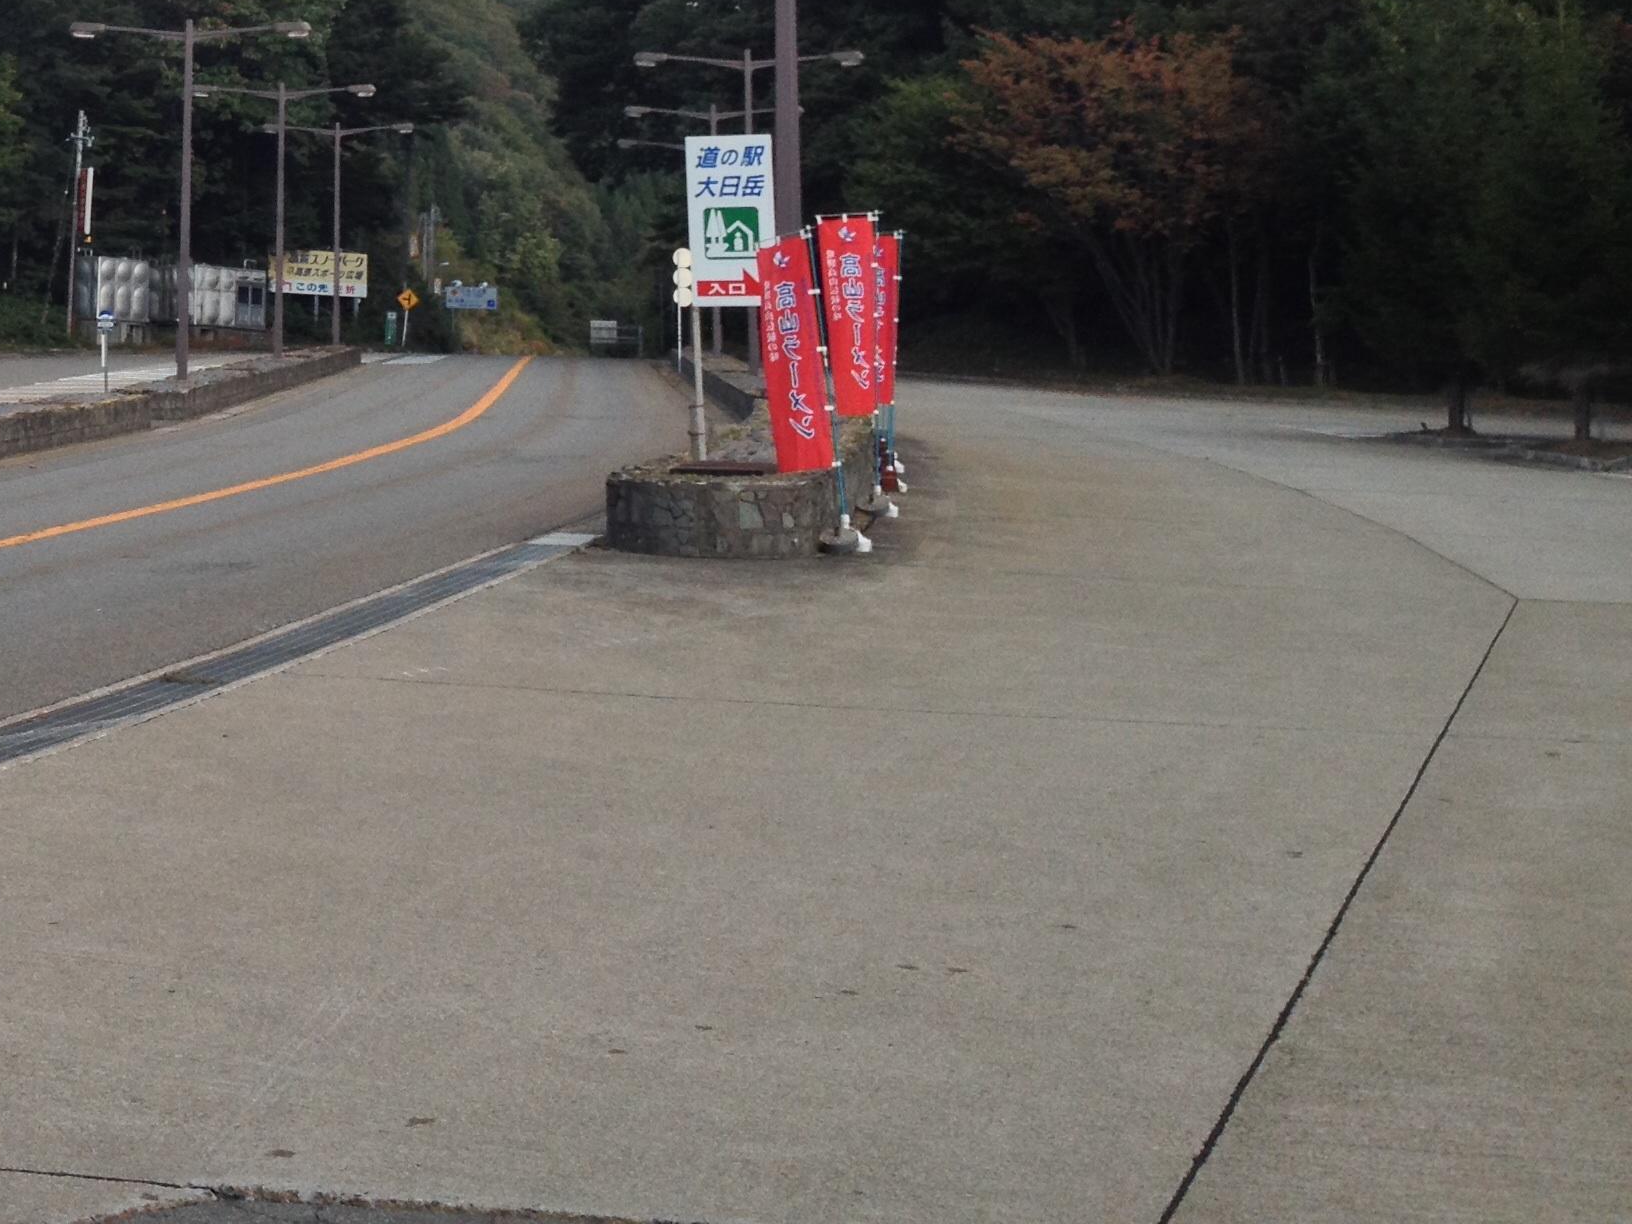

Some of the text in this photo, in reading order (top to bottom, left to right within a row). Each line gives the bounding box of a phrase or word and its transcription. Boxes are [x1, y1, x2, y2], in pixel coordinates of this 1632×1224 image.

[696, 145, 765, 168] 道の駅
[695, 175, 765, 198] 大日岳
[708, 283, 746, 295] 入口
[840, 252, 871, 390] 高山ラーメン
[774, 280, 816, 440] 高山ラーメン
